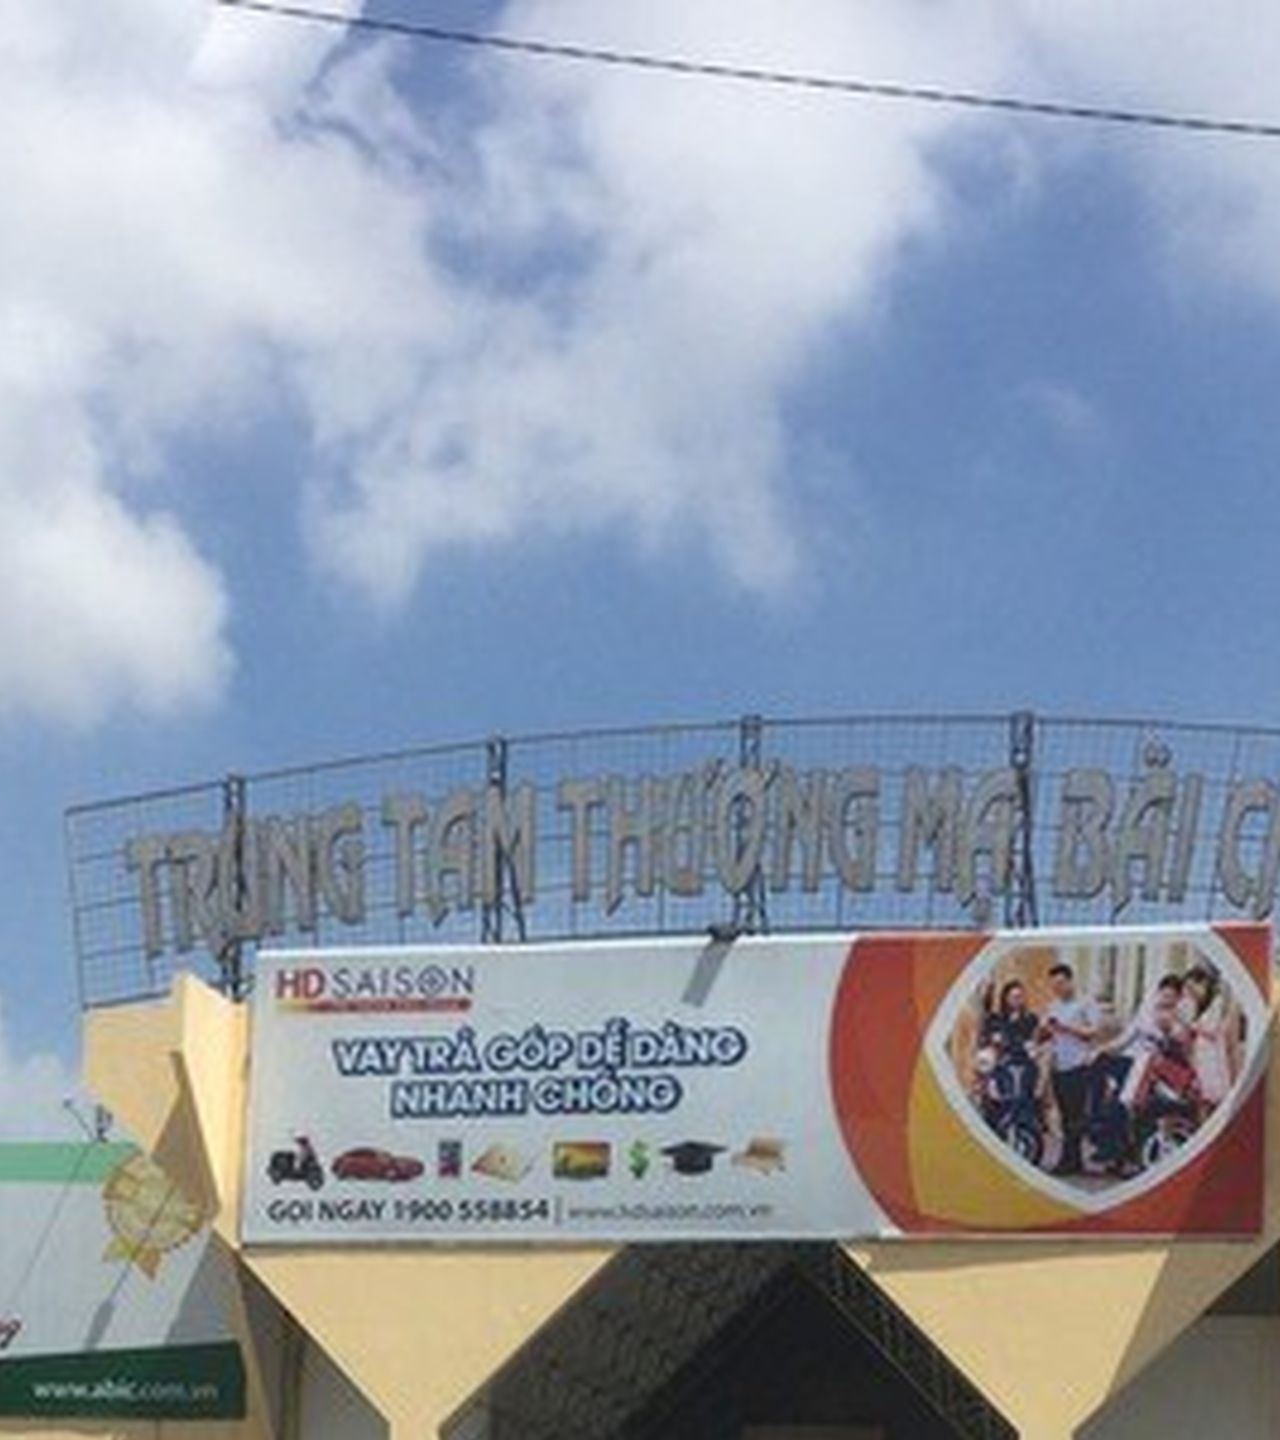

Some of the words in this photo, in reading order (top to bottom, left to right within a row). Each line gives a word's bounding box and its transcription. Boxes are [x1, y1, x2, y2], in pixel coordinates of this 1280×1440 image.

[125, 802, 366, 962] TRUNG
[331, 1038, 404, 1076] VAY
[408, 1026, 482, 1073] TRẢ
[484, 1023, 573, 1071] GÓP
[629, 1020, 748, 1066] DÀNG
[390, 1079, 528, 1118] NHANH
[318, 1198, 388, 1222] NGAY
[394, 1198, 453, 1222] 1900
